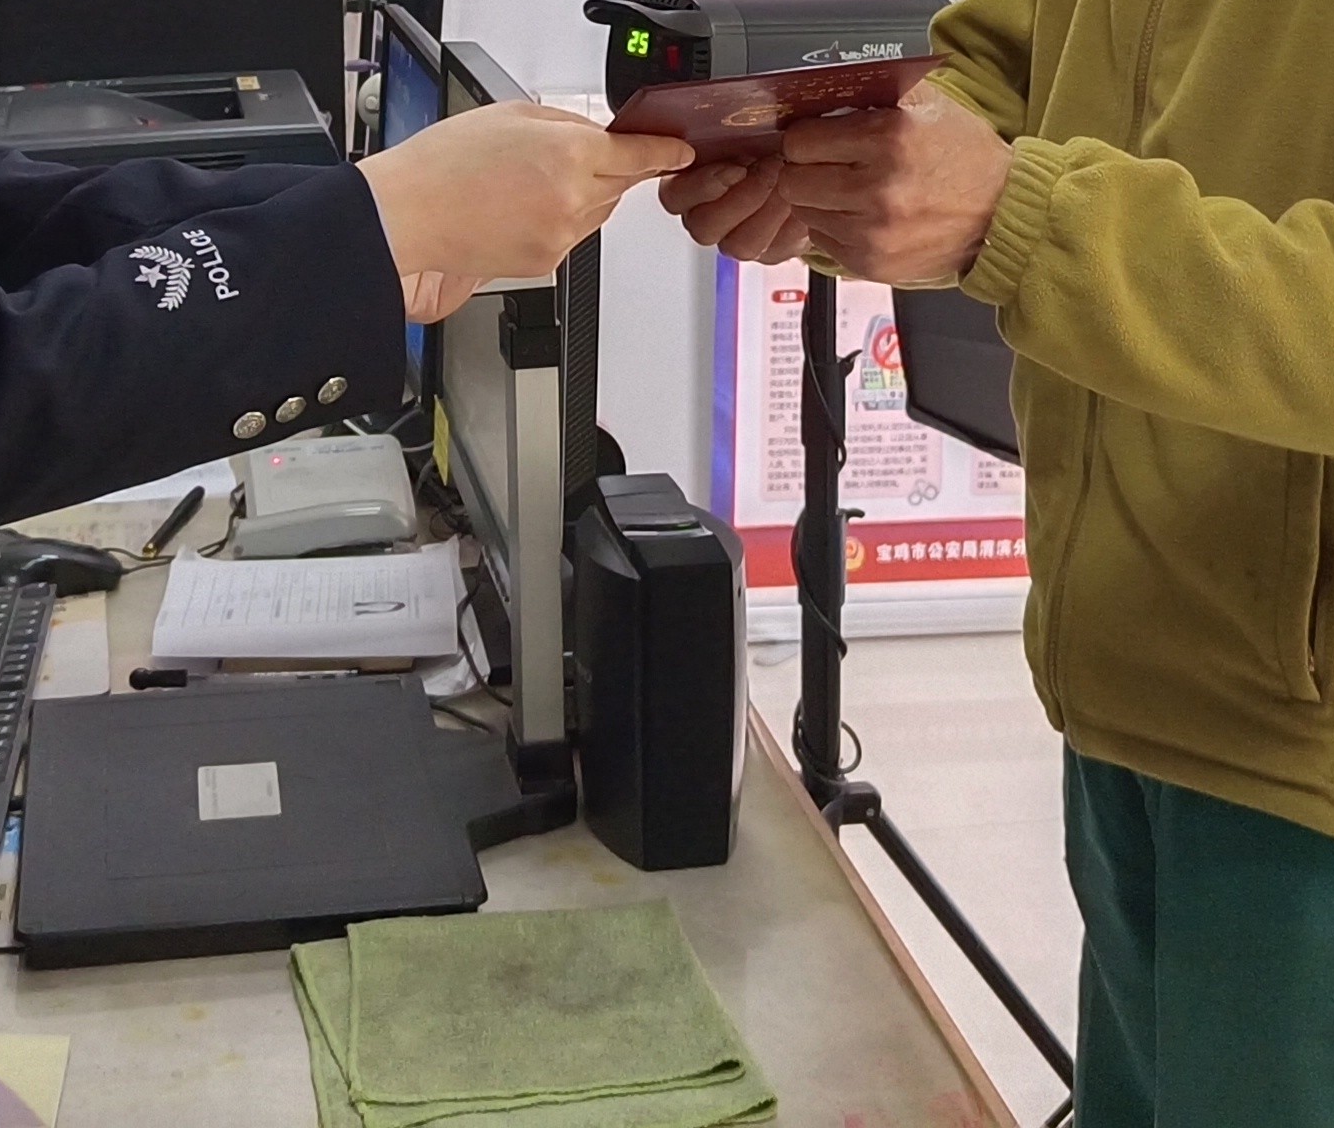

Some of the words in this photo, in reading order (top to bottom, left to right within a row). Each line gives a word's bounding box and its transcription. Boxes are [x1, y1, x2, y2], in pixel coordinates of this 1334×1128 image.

[626, 27, 651, 58] 25
[861, 42, 904, 59] SHARK
[182, 227, 240, 302] POLICE
